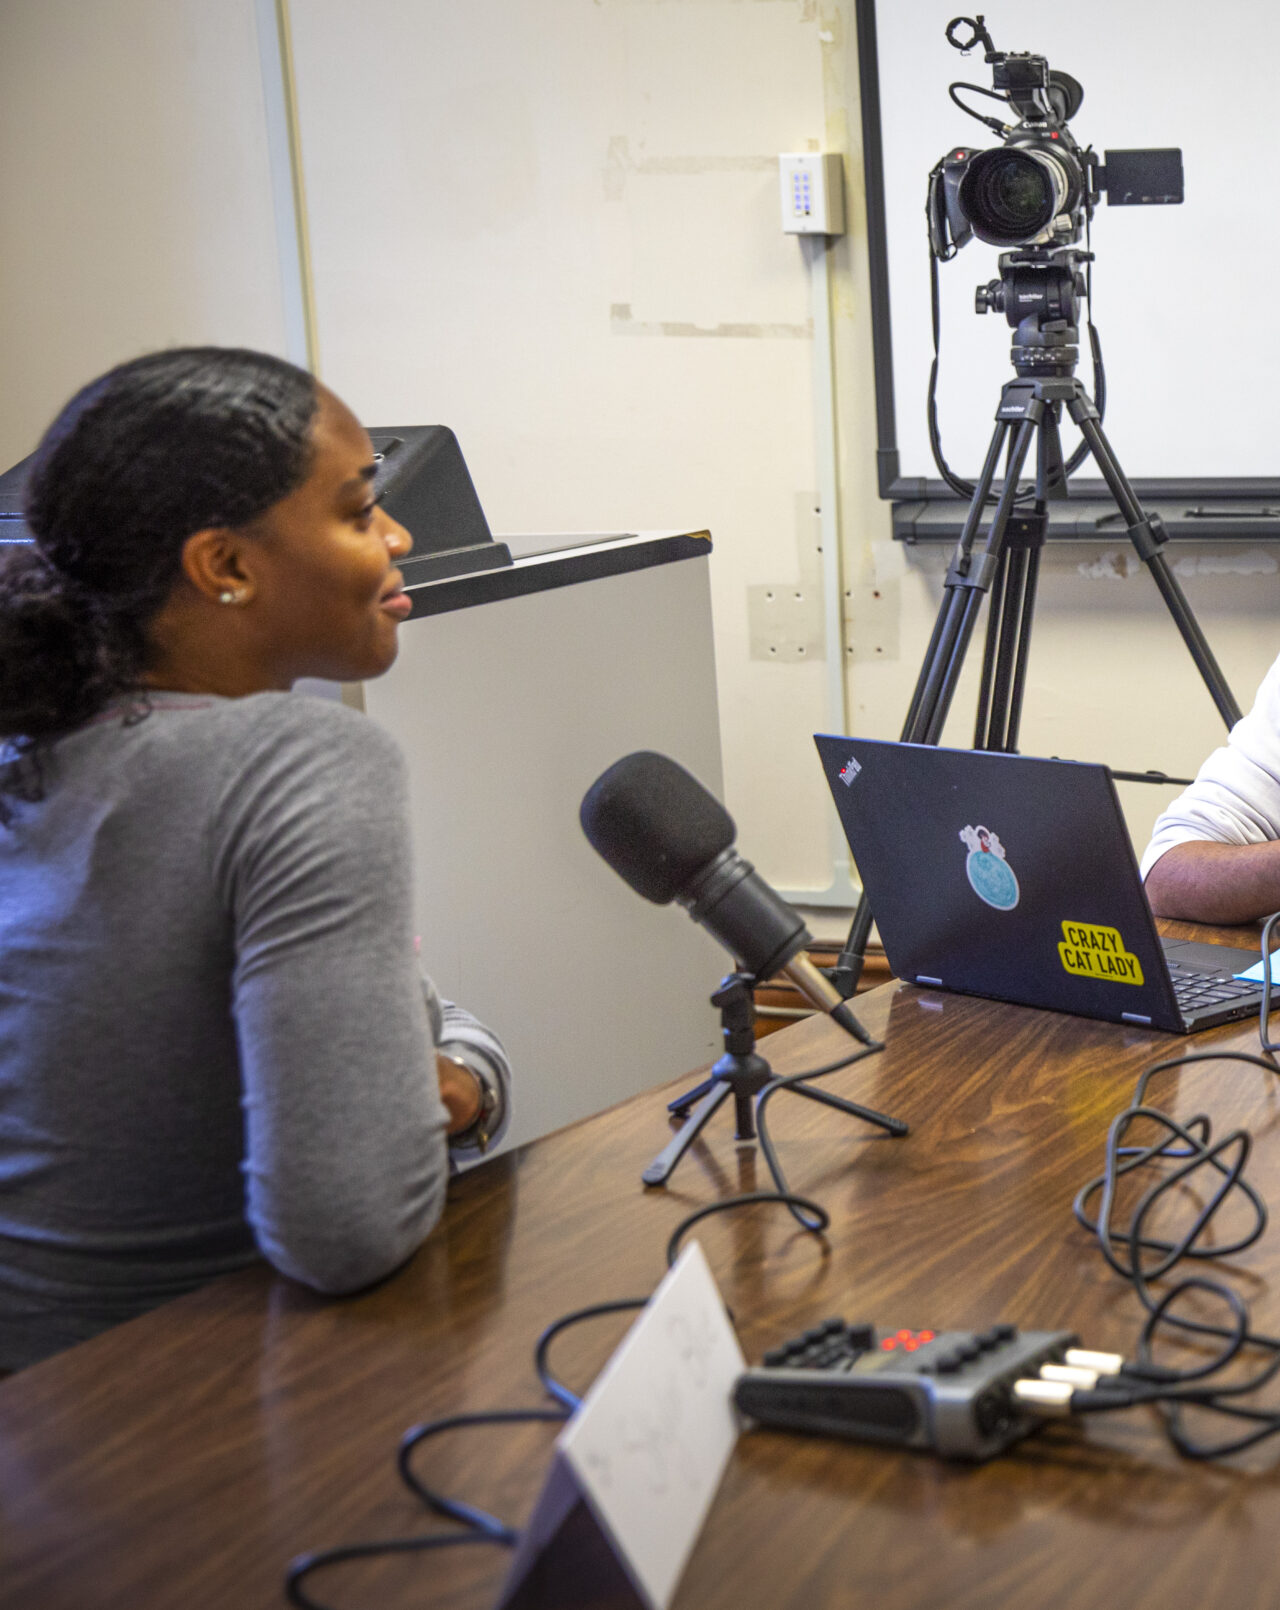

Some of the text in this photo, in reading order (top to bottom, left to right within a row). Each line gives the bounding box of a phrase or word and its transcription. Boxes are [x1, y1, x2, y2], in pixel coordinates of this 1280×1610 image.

[1068, 927, 1118, 953] CRAZY
[1064, 948, 1136, 978] CAT LADY
